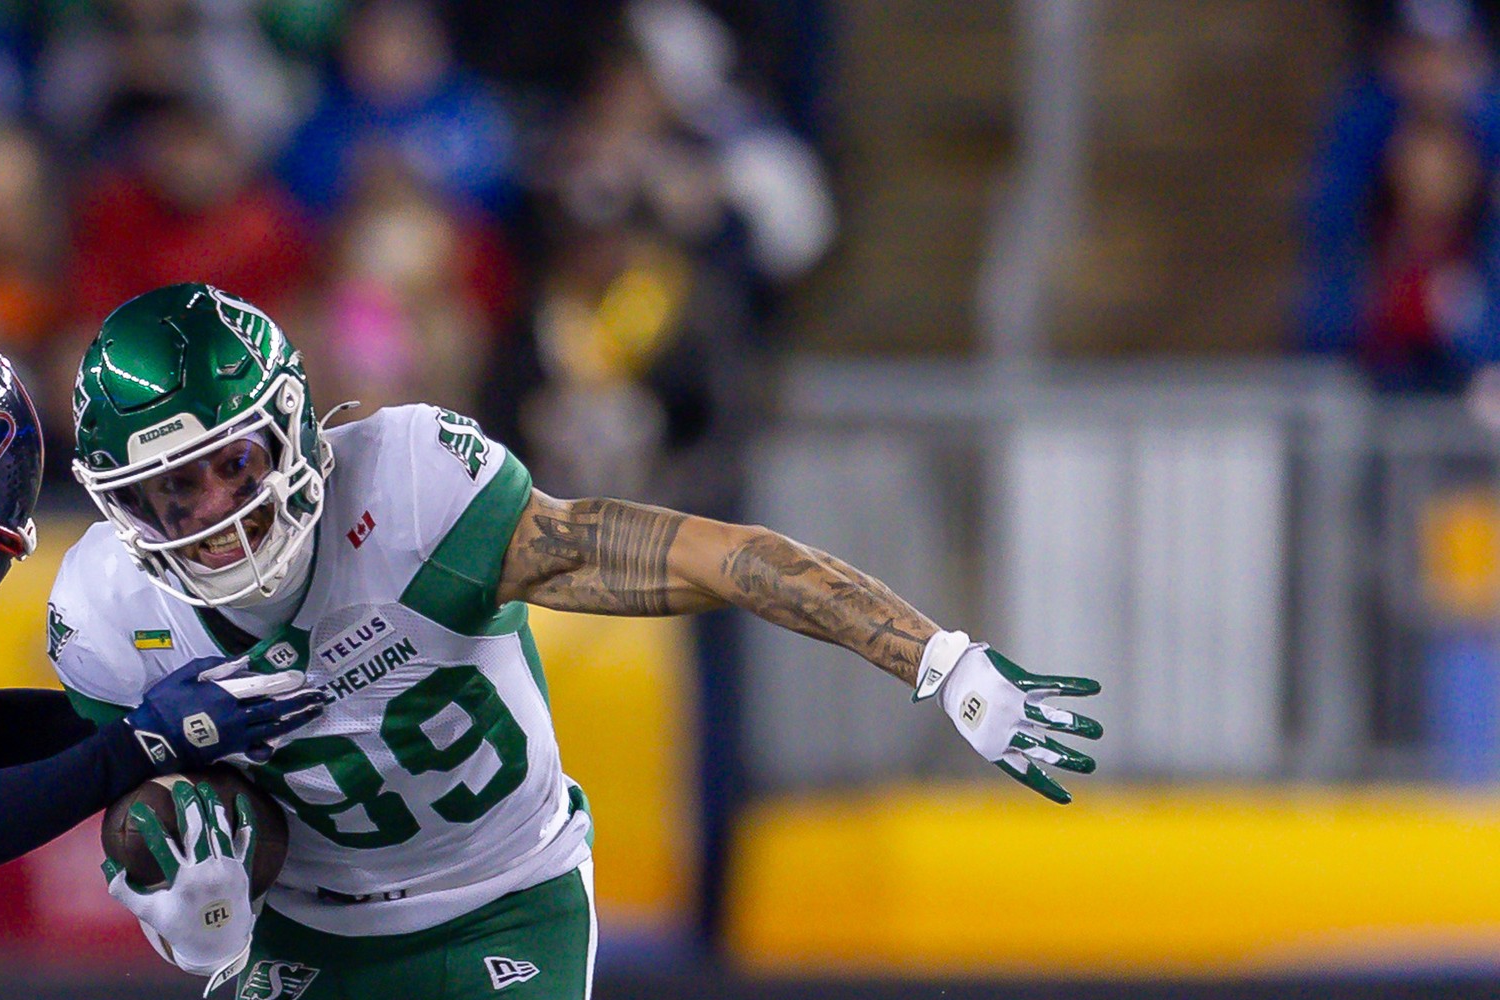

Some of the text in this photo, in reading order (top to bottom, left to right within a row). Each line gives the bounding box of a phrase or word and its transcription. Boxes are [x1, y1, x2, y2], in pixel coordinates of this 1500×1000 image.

[138, 418, 185, 445] RIDERS
[319, 615, 388, 664] TELUS
[248, 664, 529, 850] 89
[203, 906, 230, 926] CFL
